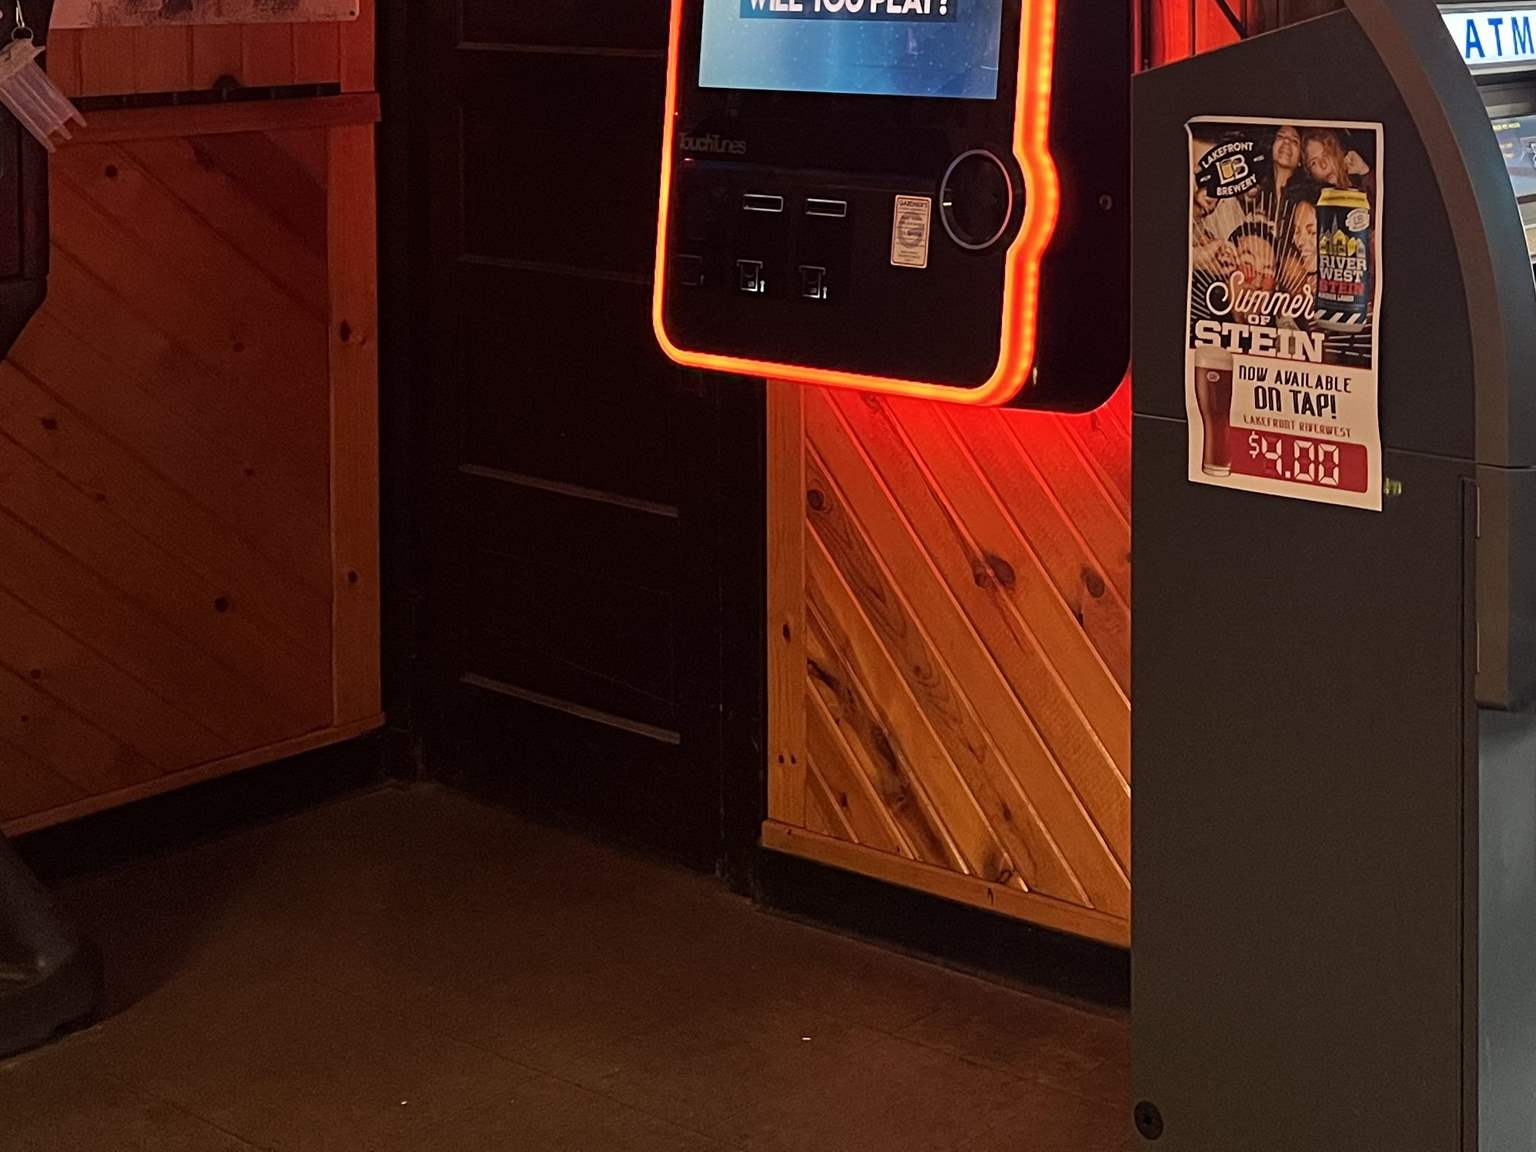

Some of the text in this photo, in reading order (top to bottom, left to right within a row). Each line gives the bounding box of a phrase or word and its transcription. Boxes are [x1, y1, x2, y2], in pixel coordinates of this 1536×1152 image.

[1465, 15, 1535, 59] ATM
[1201, 141, 1254, 169] LAKEFRONT
[1216, 174, 1258, 196] BREWERY
[1319, 256, 1367, 271] RIVER
[1319, 268, 1364, 283] WEST
[1206, 270, 1316, 320] Summer
[1247, 313, 1271, 326] OF
[1194, 319, 1325, 362] STEIN
[1239, 365, 1352, 393] NOW AVAILABLE
[1254, 385, 1337, 420] ON TAP!
[1243, 414, 1352, 438] LAKEFRONT RIVERWEST
[1248, 431, 1340, 486] $4.00
